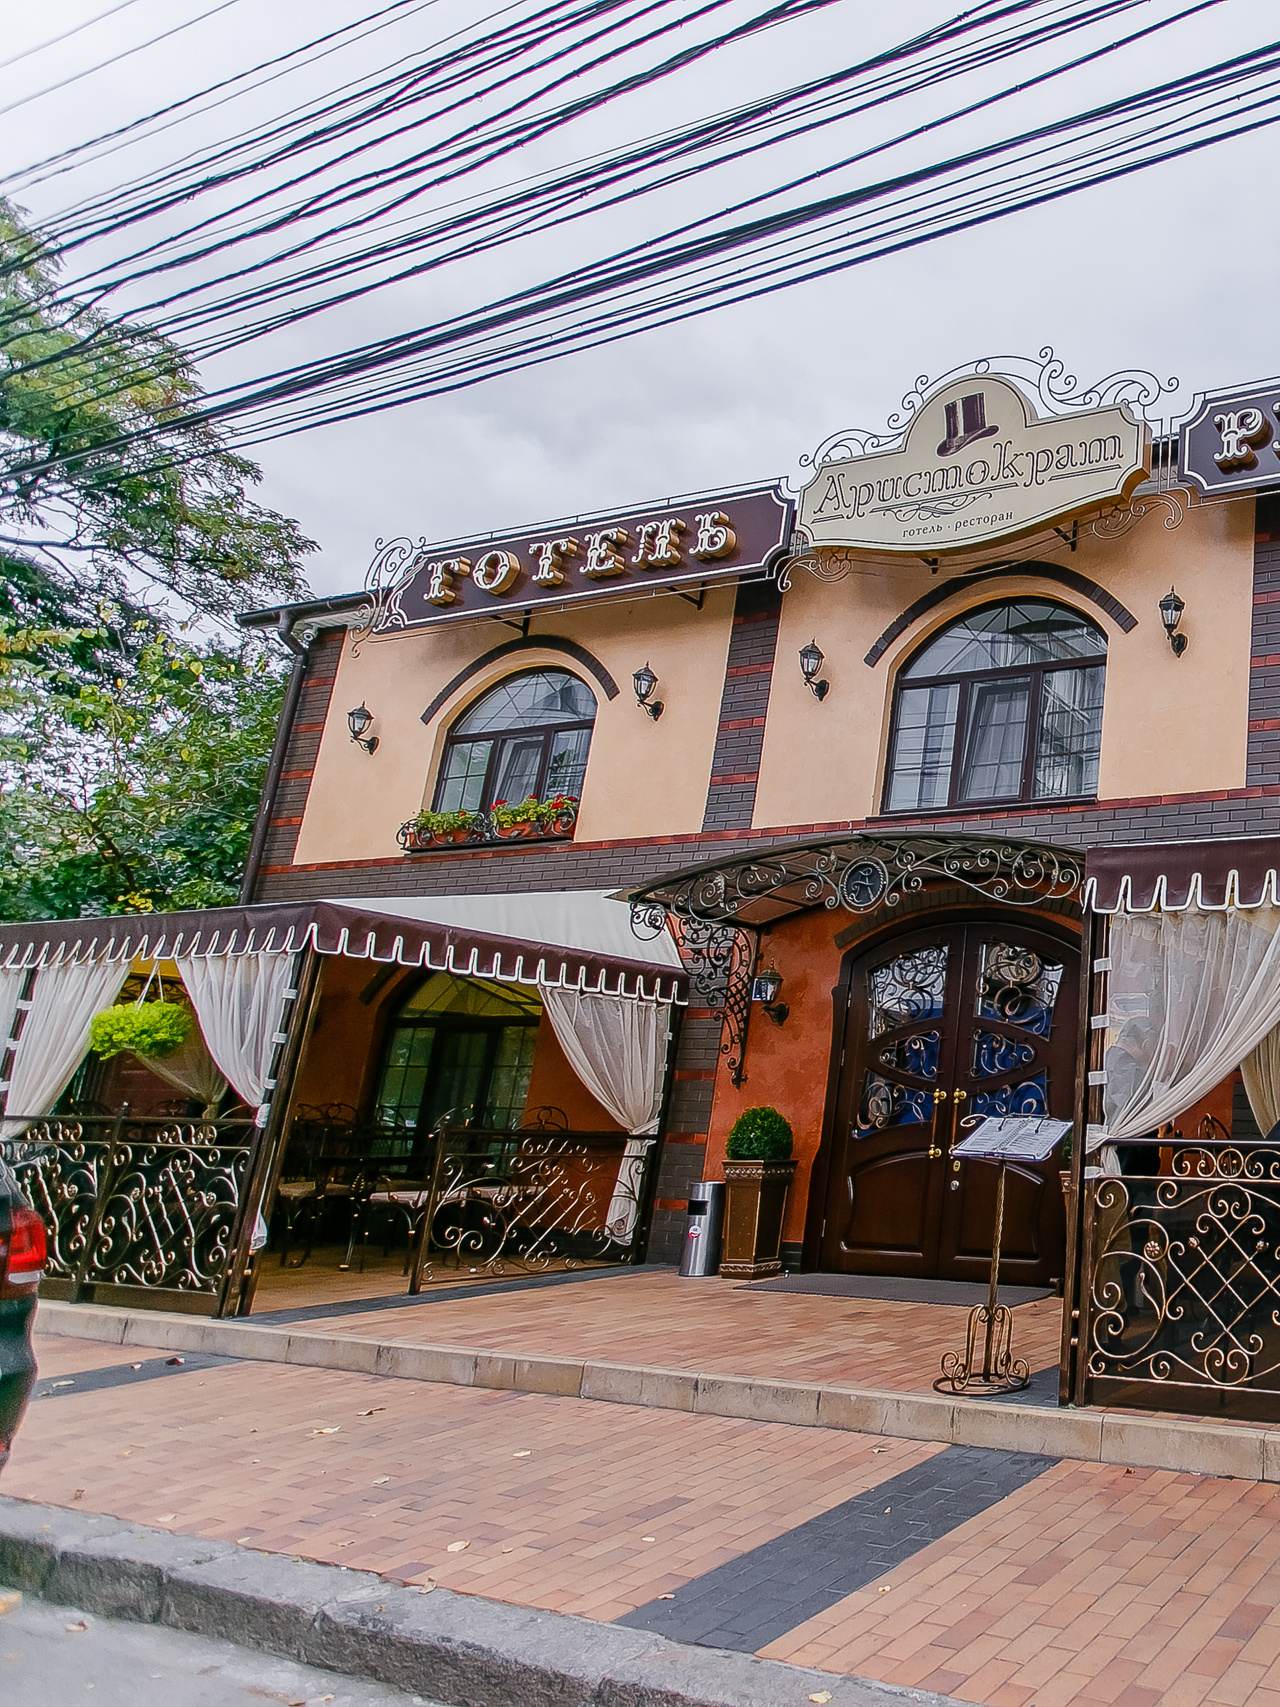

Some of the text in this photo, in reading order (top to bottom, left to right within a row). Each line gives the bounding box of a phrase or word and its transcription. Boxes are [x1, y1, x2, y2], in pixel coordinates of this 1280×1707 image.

[902, 511, 1014, 538] готель ресторан
[422, 510, 738, 606] ГОТЕЛЬ
